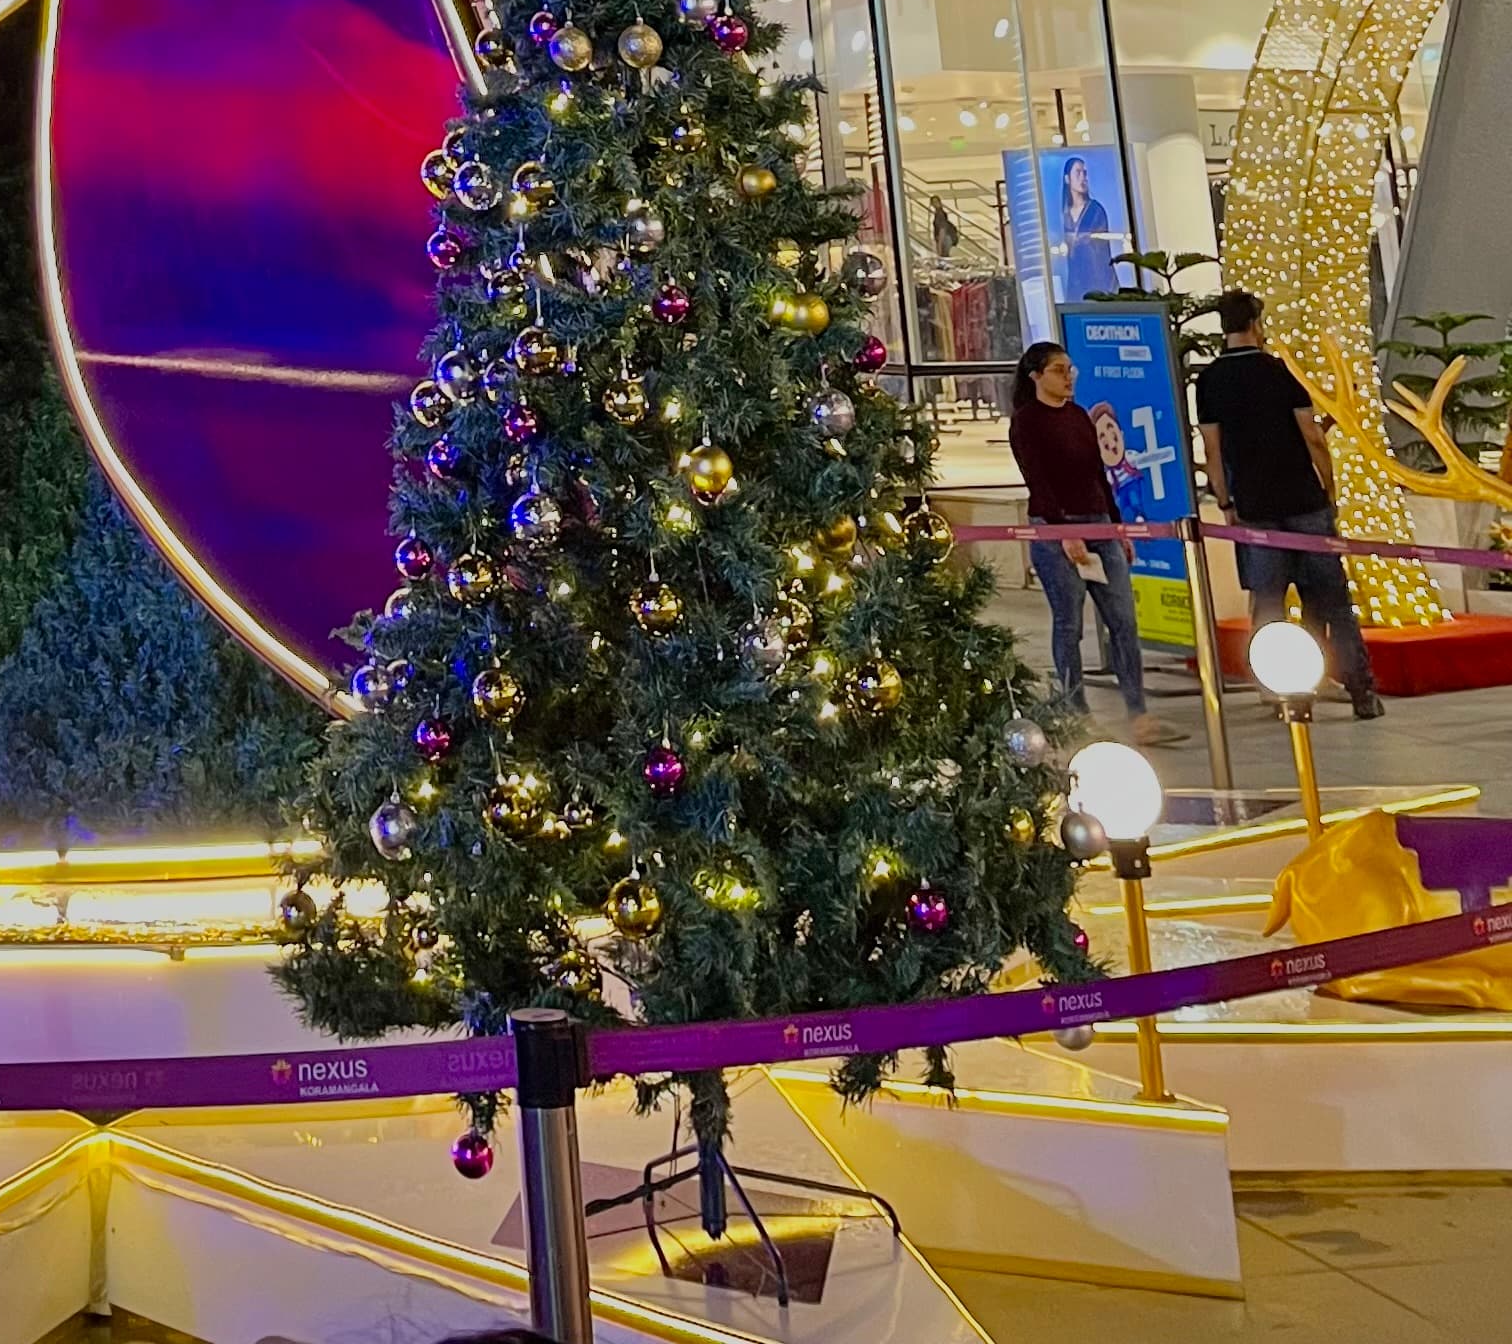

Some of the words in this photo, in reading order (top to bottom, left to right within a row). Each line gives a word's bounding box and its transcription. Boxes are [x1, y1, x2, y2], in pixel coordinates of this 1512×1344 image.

[1286, 953, 1326, 974] nexus
[1059, 991, 1102, 1012] nexus
[803, 1023, 853, 1044] nexus
[298, 1059, 368, 1082] nexus
[299, 1082, 380, 1097] KORAMANGALA
